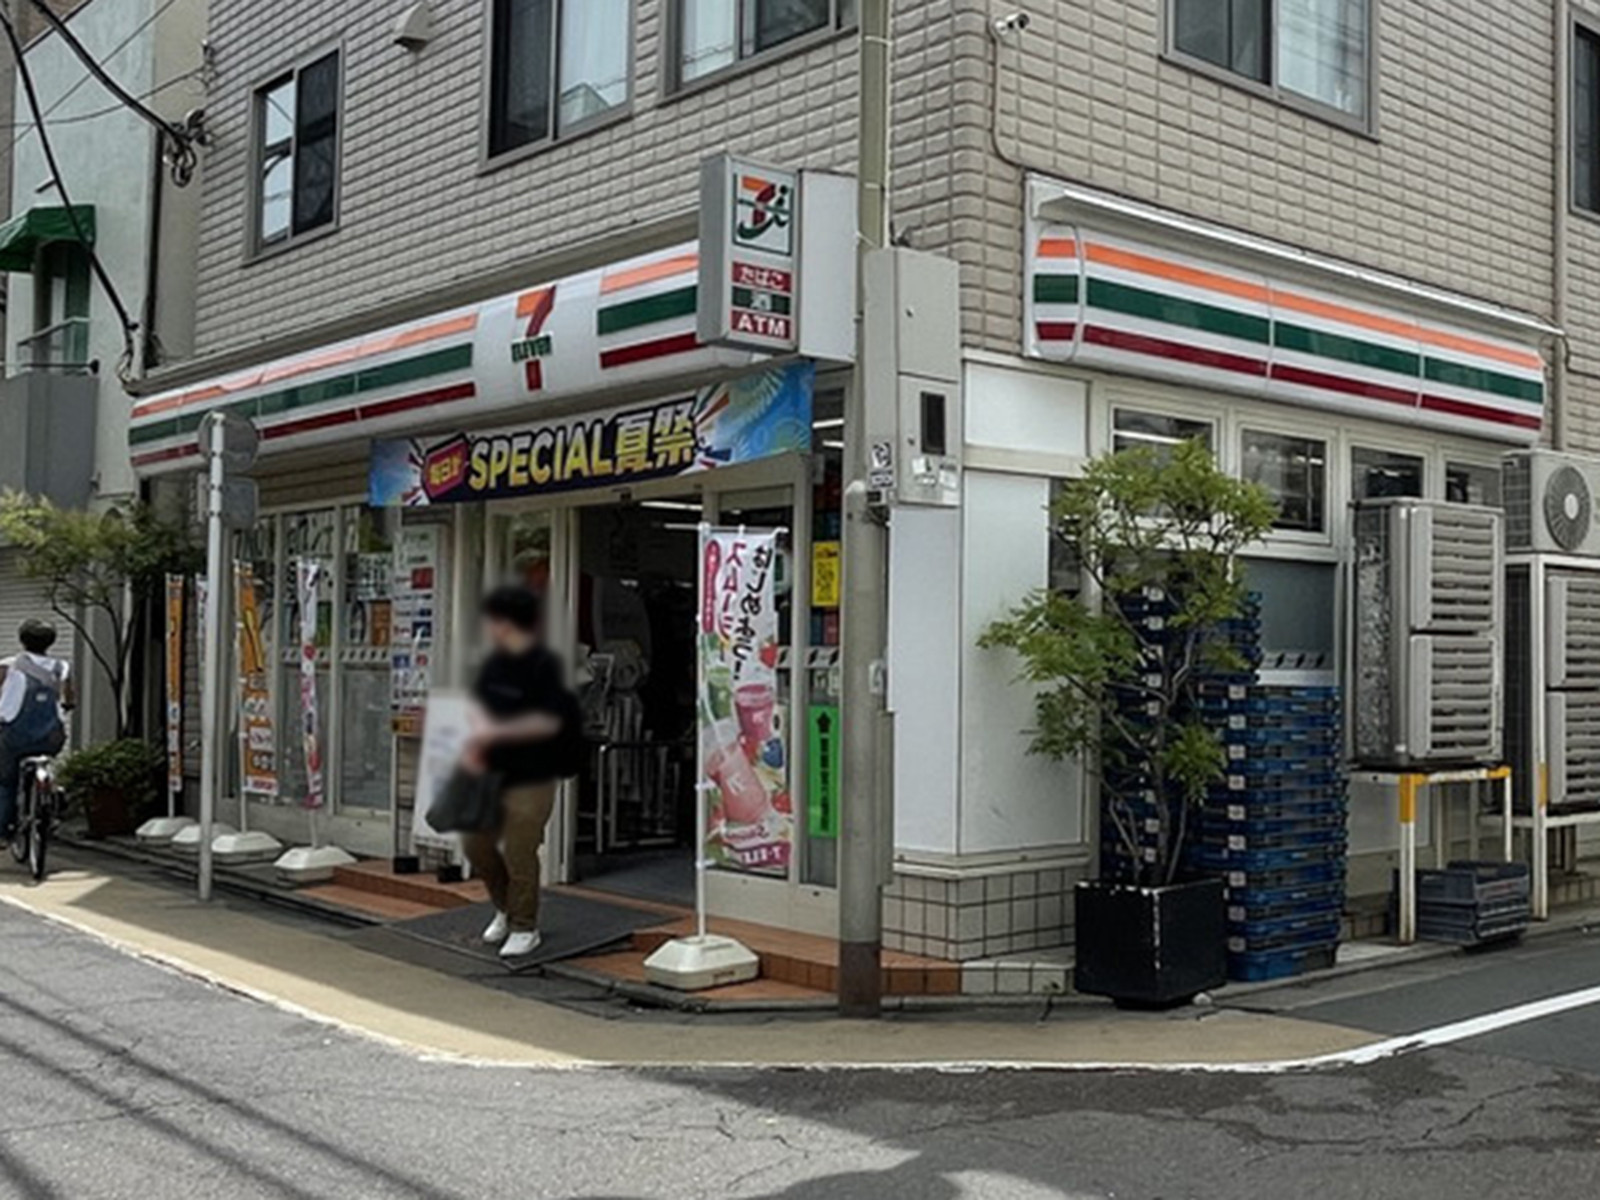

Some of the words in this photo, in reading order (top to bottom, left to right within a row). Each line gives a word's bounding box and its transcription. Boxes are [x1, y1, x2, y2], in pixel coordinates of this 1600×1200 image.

[740, 266, 785, 290] たばこ
[738, 314, 786, 337] ATM
[516, 285, 557, 391] 7
